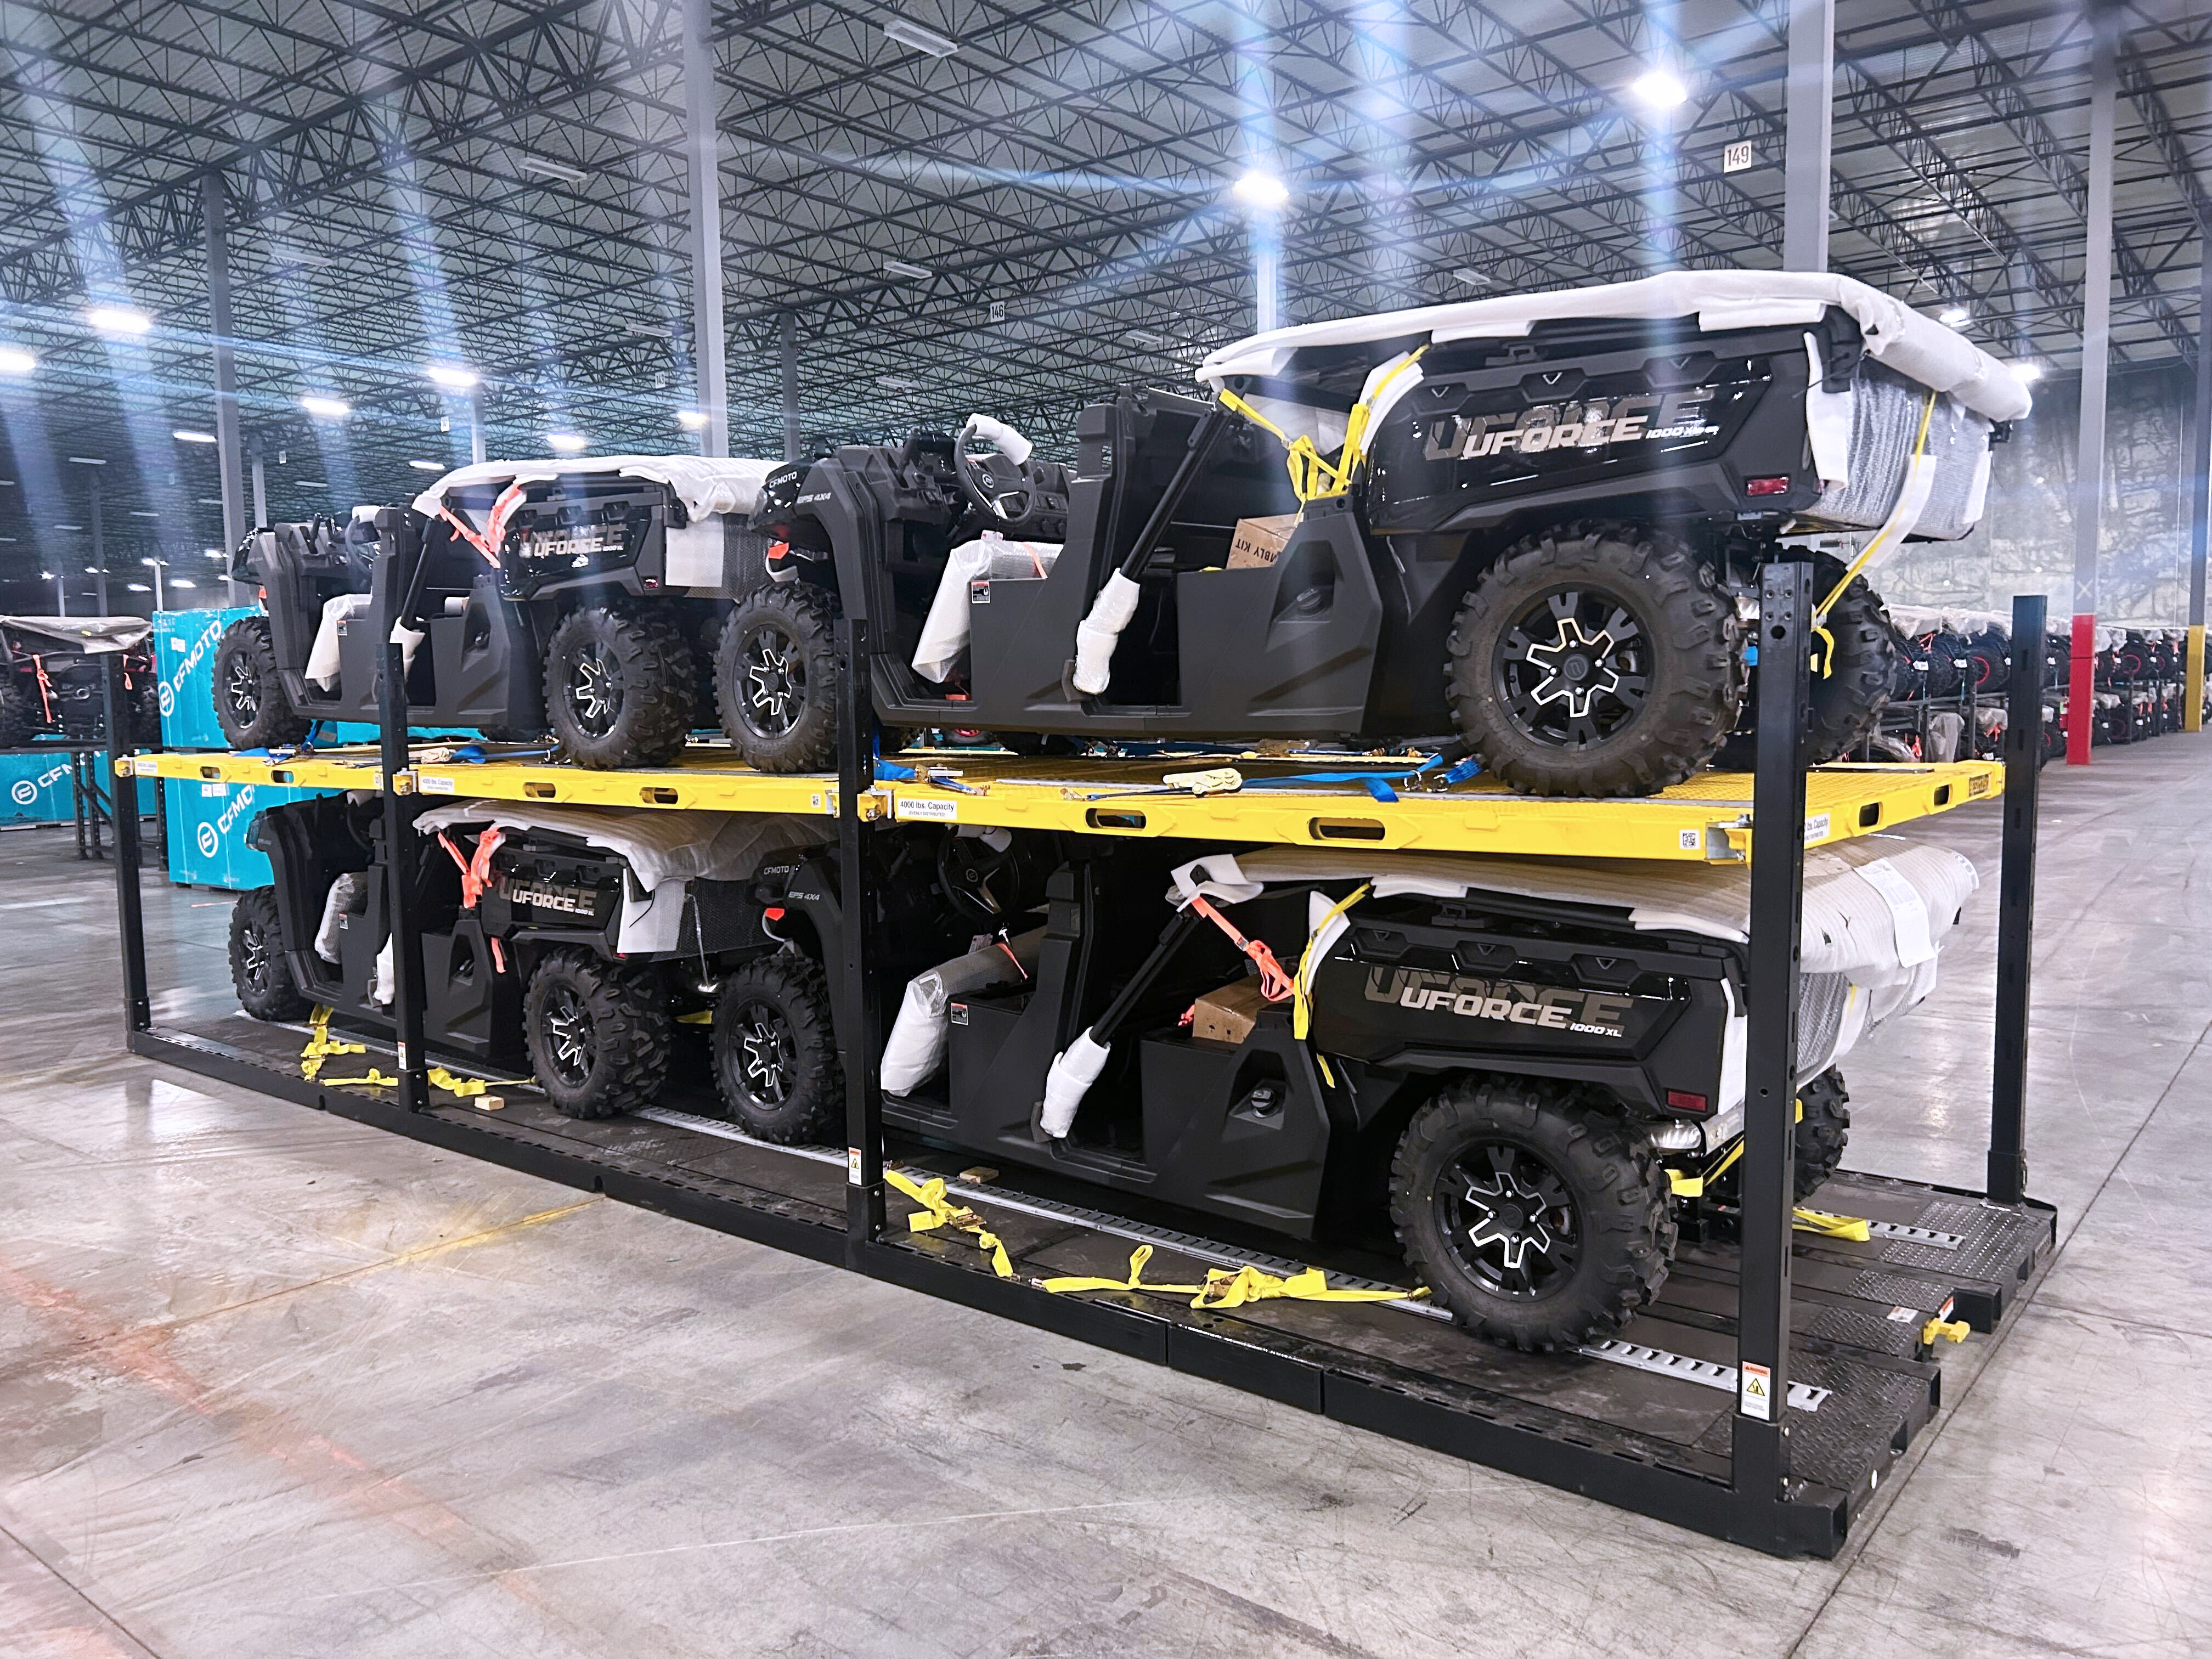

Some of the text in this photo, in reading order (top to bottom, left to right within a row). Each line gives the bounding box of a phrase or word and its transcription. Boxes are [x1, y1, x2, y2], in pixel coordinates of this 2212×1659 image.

[1727, 145, 1749, 166] 149
[991, 304, 1003, 319] 146
[1463, 416, 1649, 458] UFORCE
[1646, 427, 1684, 439] 1000
[769, 471, 797, 488] CFMOTO
[797, 494, 814, 504] EPS
[534, 538, 603, 556] UFORCE
[1235, 539, 1251, 552] KIT
[173, 620, 221, 692] CFMOTO
[217, 785, 255, 834] CFMO
[928, 802, 954, 812] Capacity
[764, 865, 789, 874] CFMOTO
[512, 889, 575, 912] UFORCE
[1400, 987, 1622, 1037] UFORCE 1000 XL
